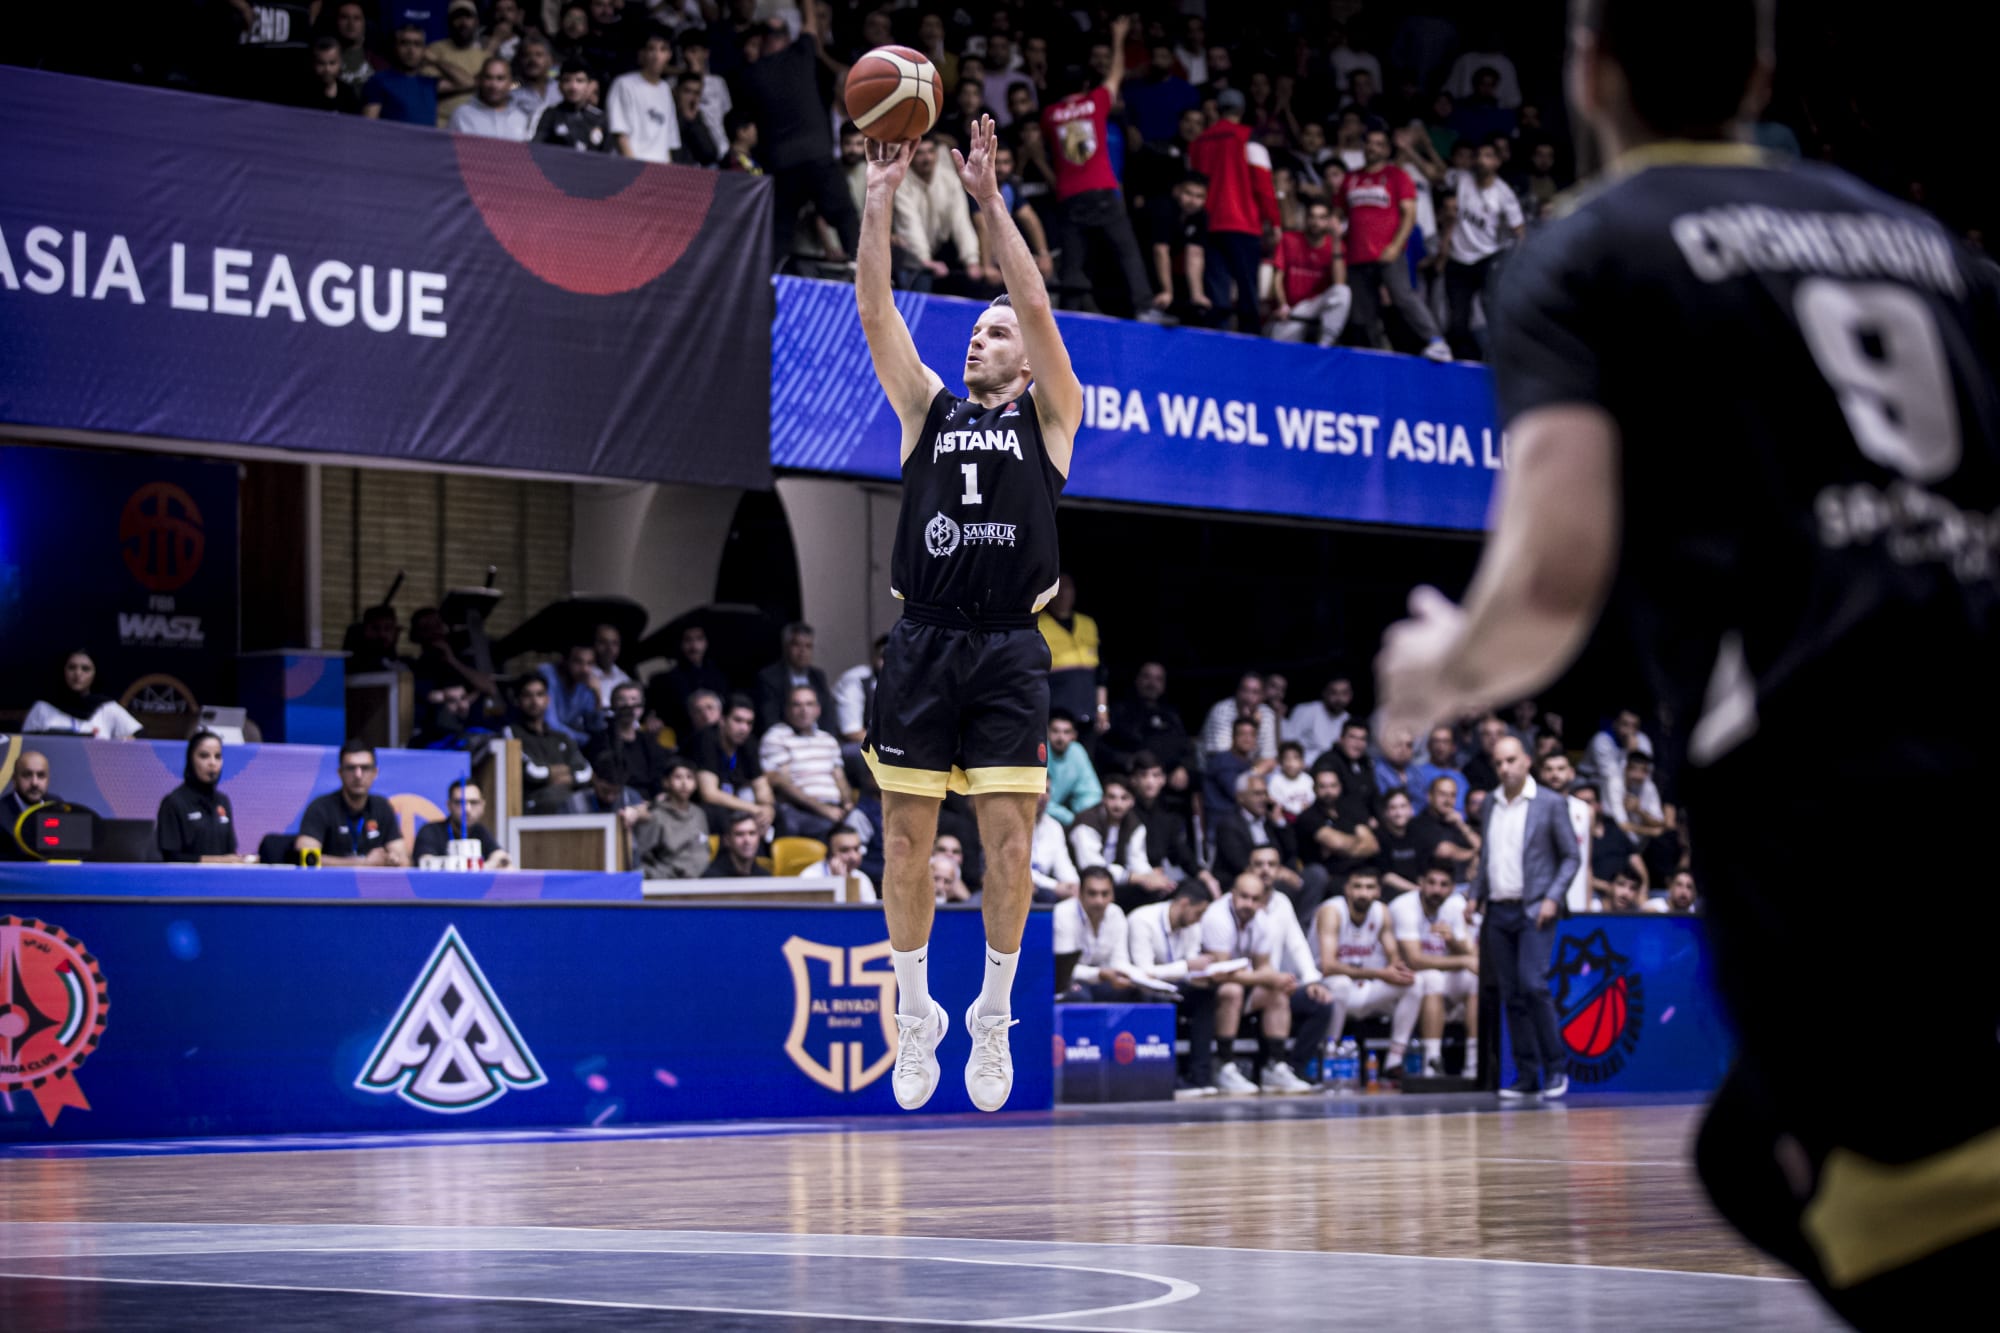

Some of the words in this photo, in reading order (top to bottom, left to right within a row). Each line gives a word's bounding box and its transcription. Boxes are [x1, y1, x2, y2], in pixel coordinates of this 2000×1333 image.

[240, 7, 291, 44] END
[171, 242, 447, 338] LEAGUE
[1795, 277, 1962, 483] 9
[1082, 385, 1150, 433] IBA
[1158, 392, 1268, 446] WASL
[1275, 406, 1380, 456] WEST
[1388, 419, 1474, 466] ASIA
[933, 429, 1024, 464] ASTANA
[961, 463, 982, 505] 1
[963, 525, 1016, 539] SAMRUK
[812, 1000, 829, 1013] AL
[832, 999, 879, 1013] RIYADI
[27, 1053, 58, 1073] CLUB
